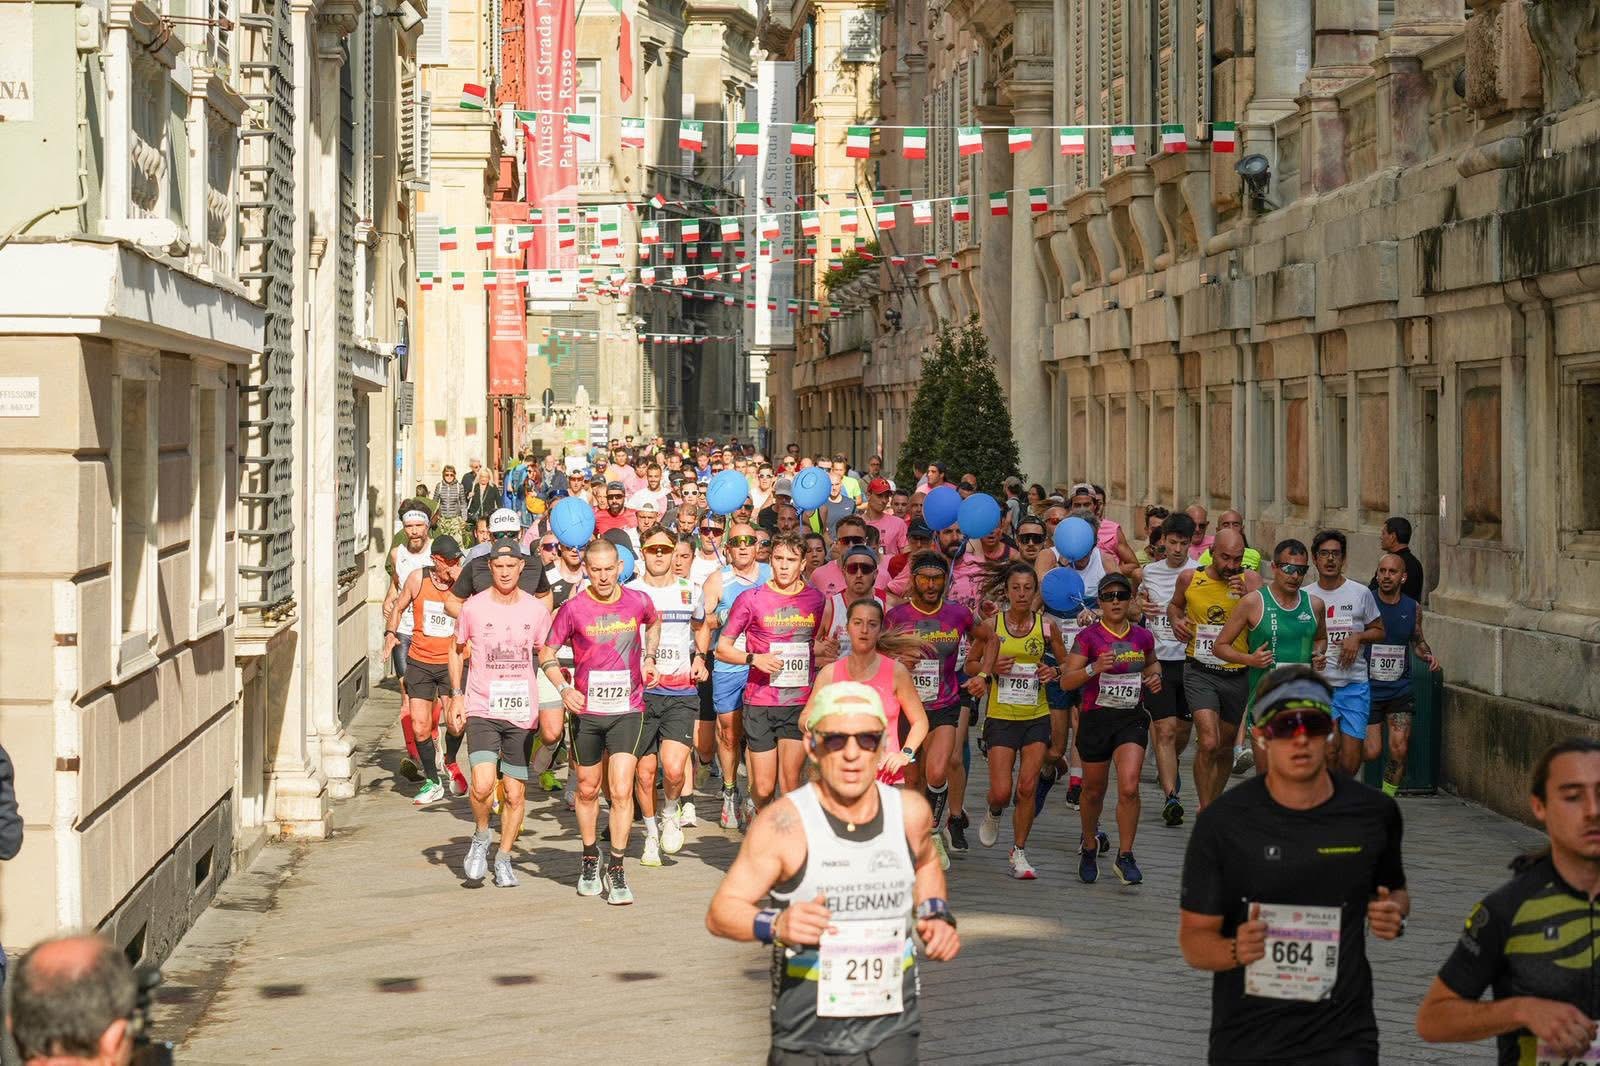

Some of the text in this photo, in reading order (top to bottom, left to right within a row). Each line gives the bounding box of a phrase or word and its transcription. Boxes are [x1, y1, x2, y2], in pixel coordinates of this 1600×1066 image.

[537, 15, 552, 77] Strada
[560, 49, 572, 99] Rosso
[537, 83, 552, 101] di
[538, 109, 553, 167] Musei
[494, 514, 516, 524] ciele
[430, 615, 446, 625] 508
[1161, 616, 1171, 627] 15
[1329, 631, 1346, 642] 727
[1202, 640, 1214, 650] 13
[1380, 658, 1396, 669] 307
[1010, 678, 1029, 690] 786
[597, 687, 623, 698] 2172
[1108, 686, 1133, 697] 2175
[498, 697, 523, 708] 1756
[826, 892, 905, 913] ELEGNANO
[1272, 941, 1314, 966] 664
[846, 958, 883, 981] 219
